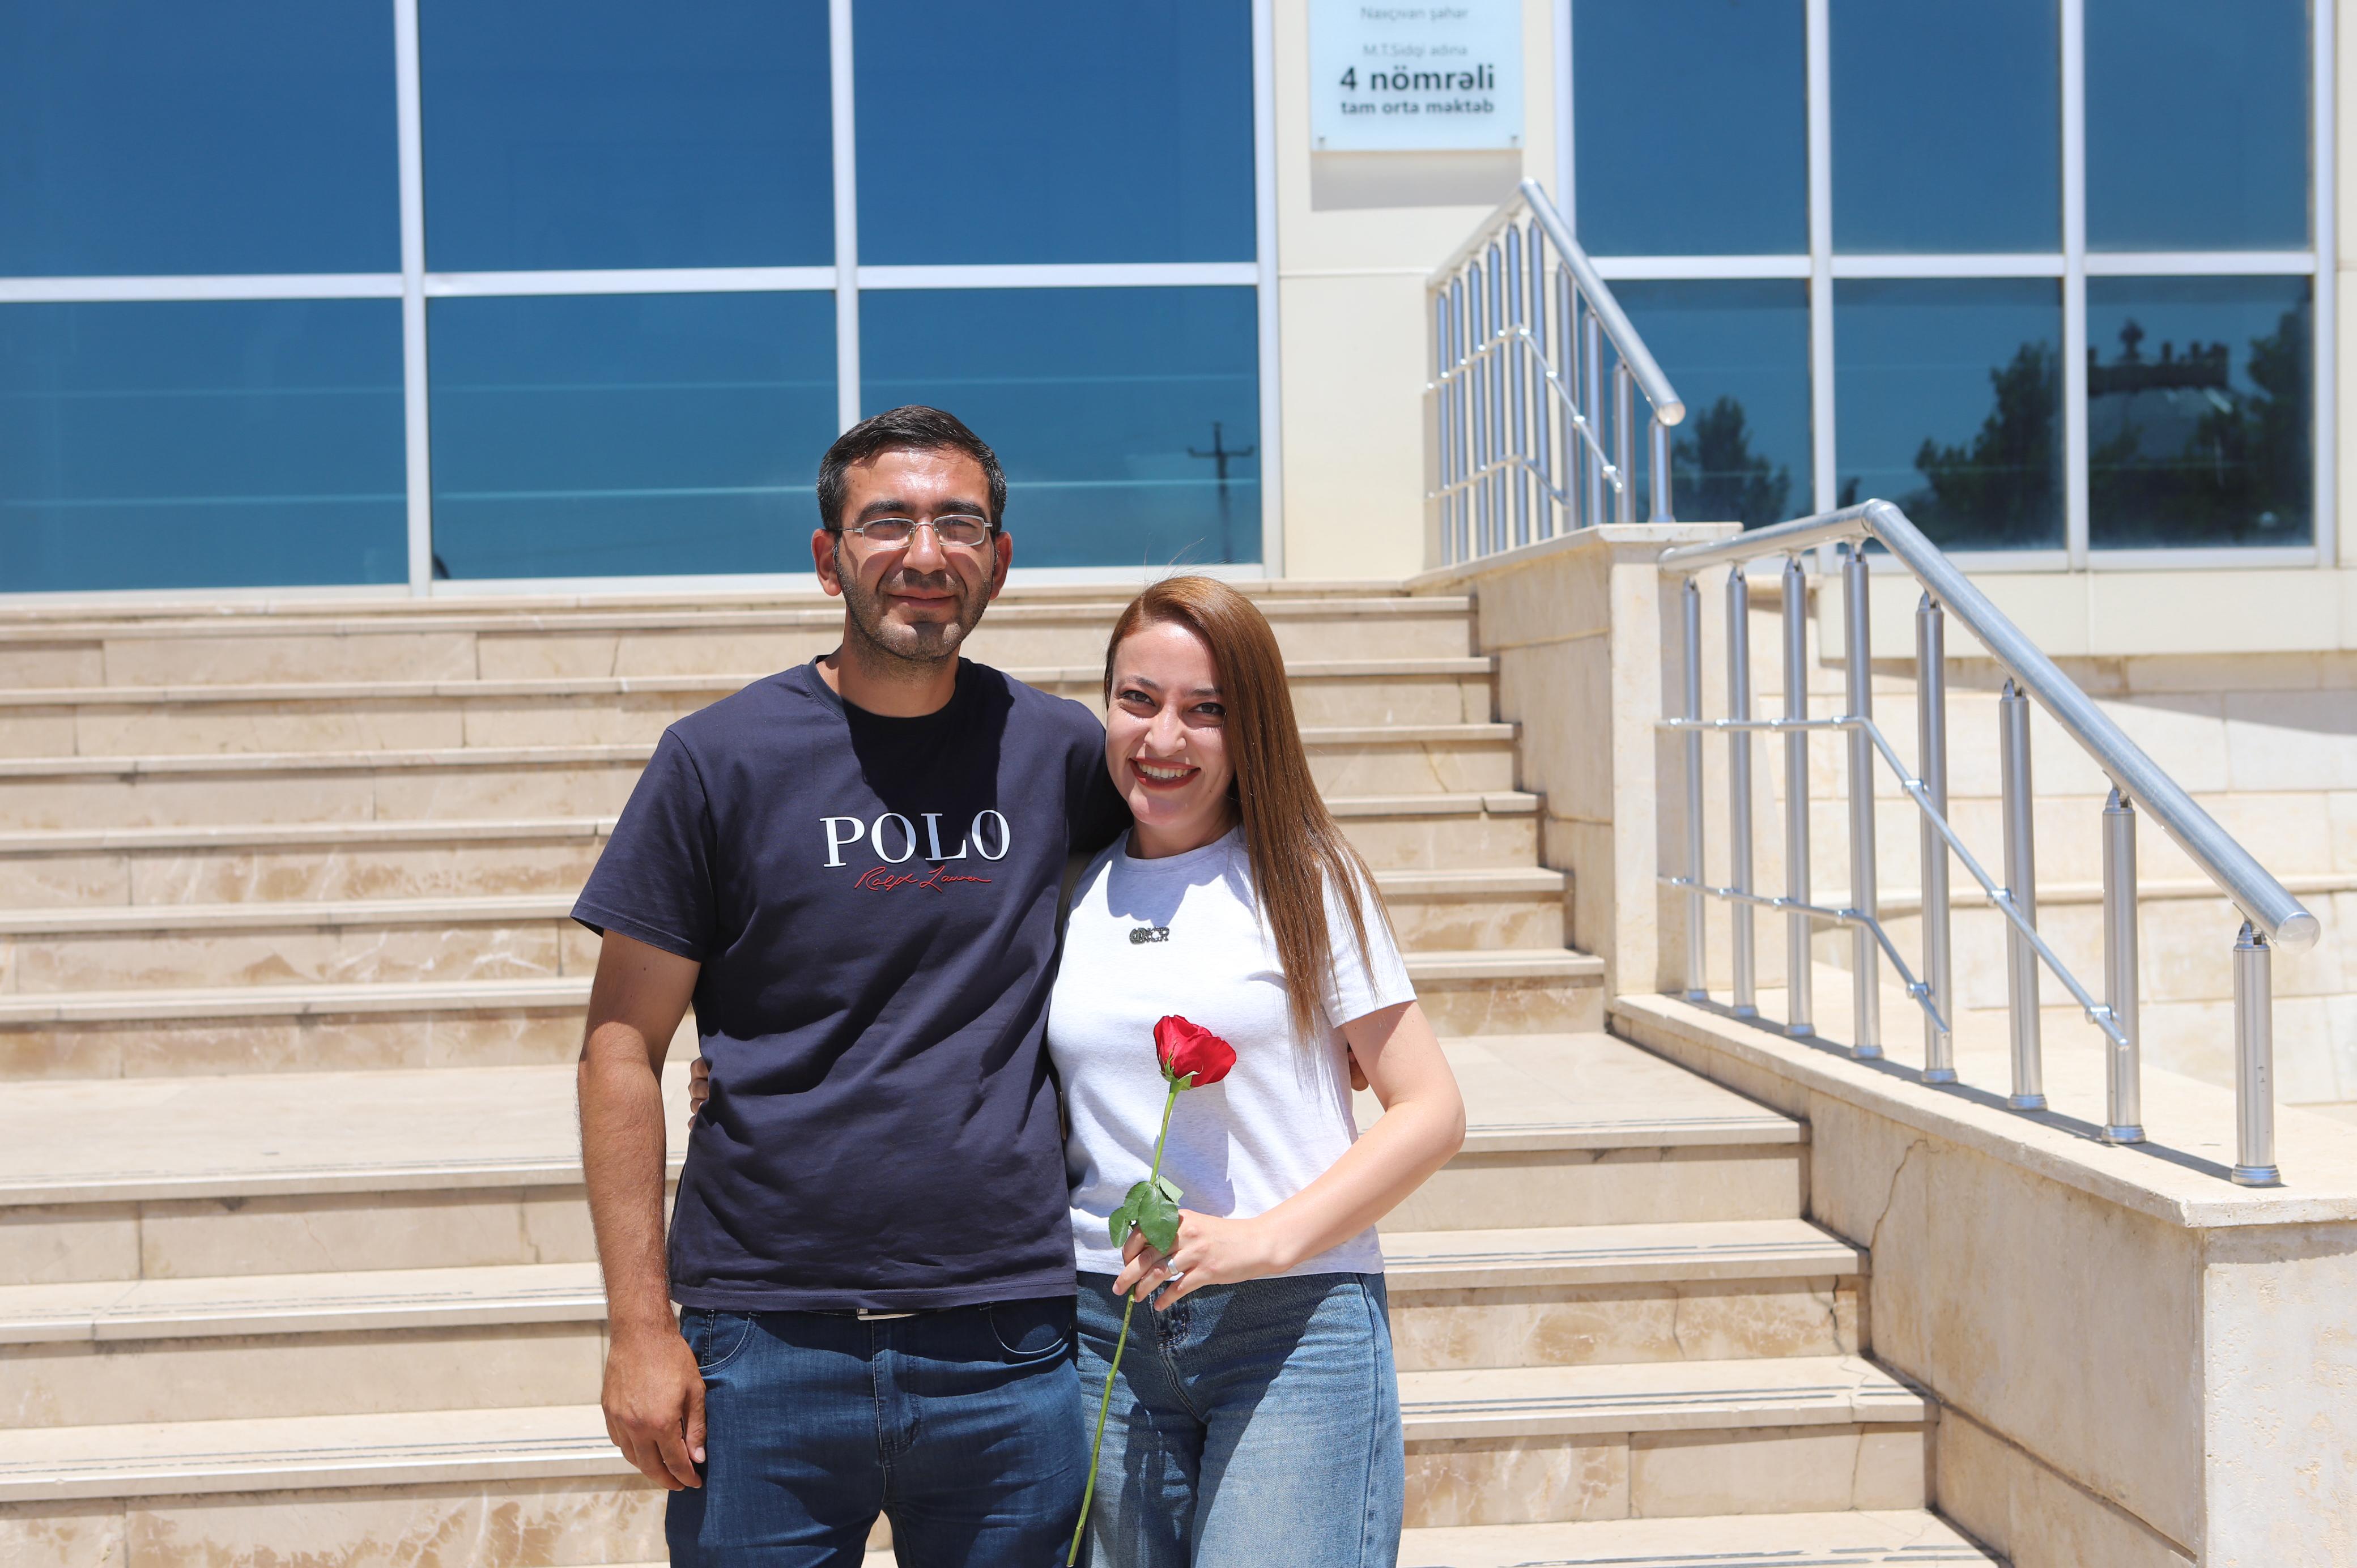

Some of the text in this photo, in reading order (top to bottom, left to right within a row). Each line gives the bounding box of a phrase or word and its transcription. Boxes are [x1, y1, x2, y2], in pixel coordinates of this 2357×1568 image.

[1339, 64, 1495, 91] 4 nömrəli
[1341, 99, 1495, 114] tam orta məktəb
[819, 809, 1010, 867] POLO
